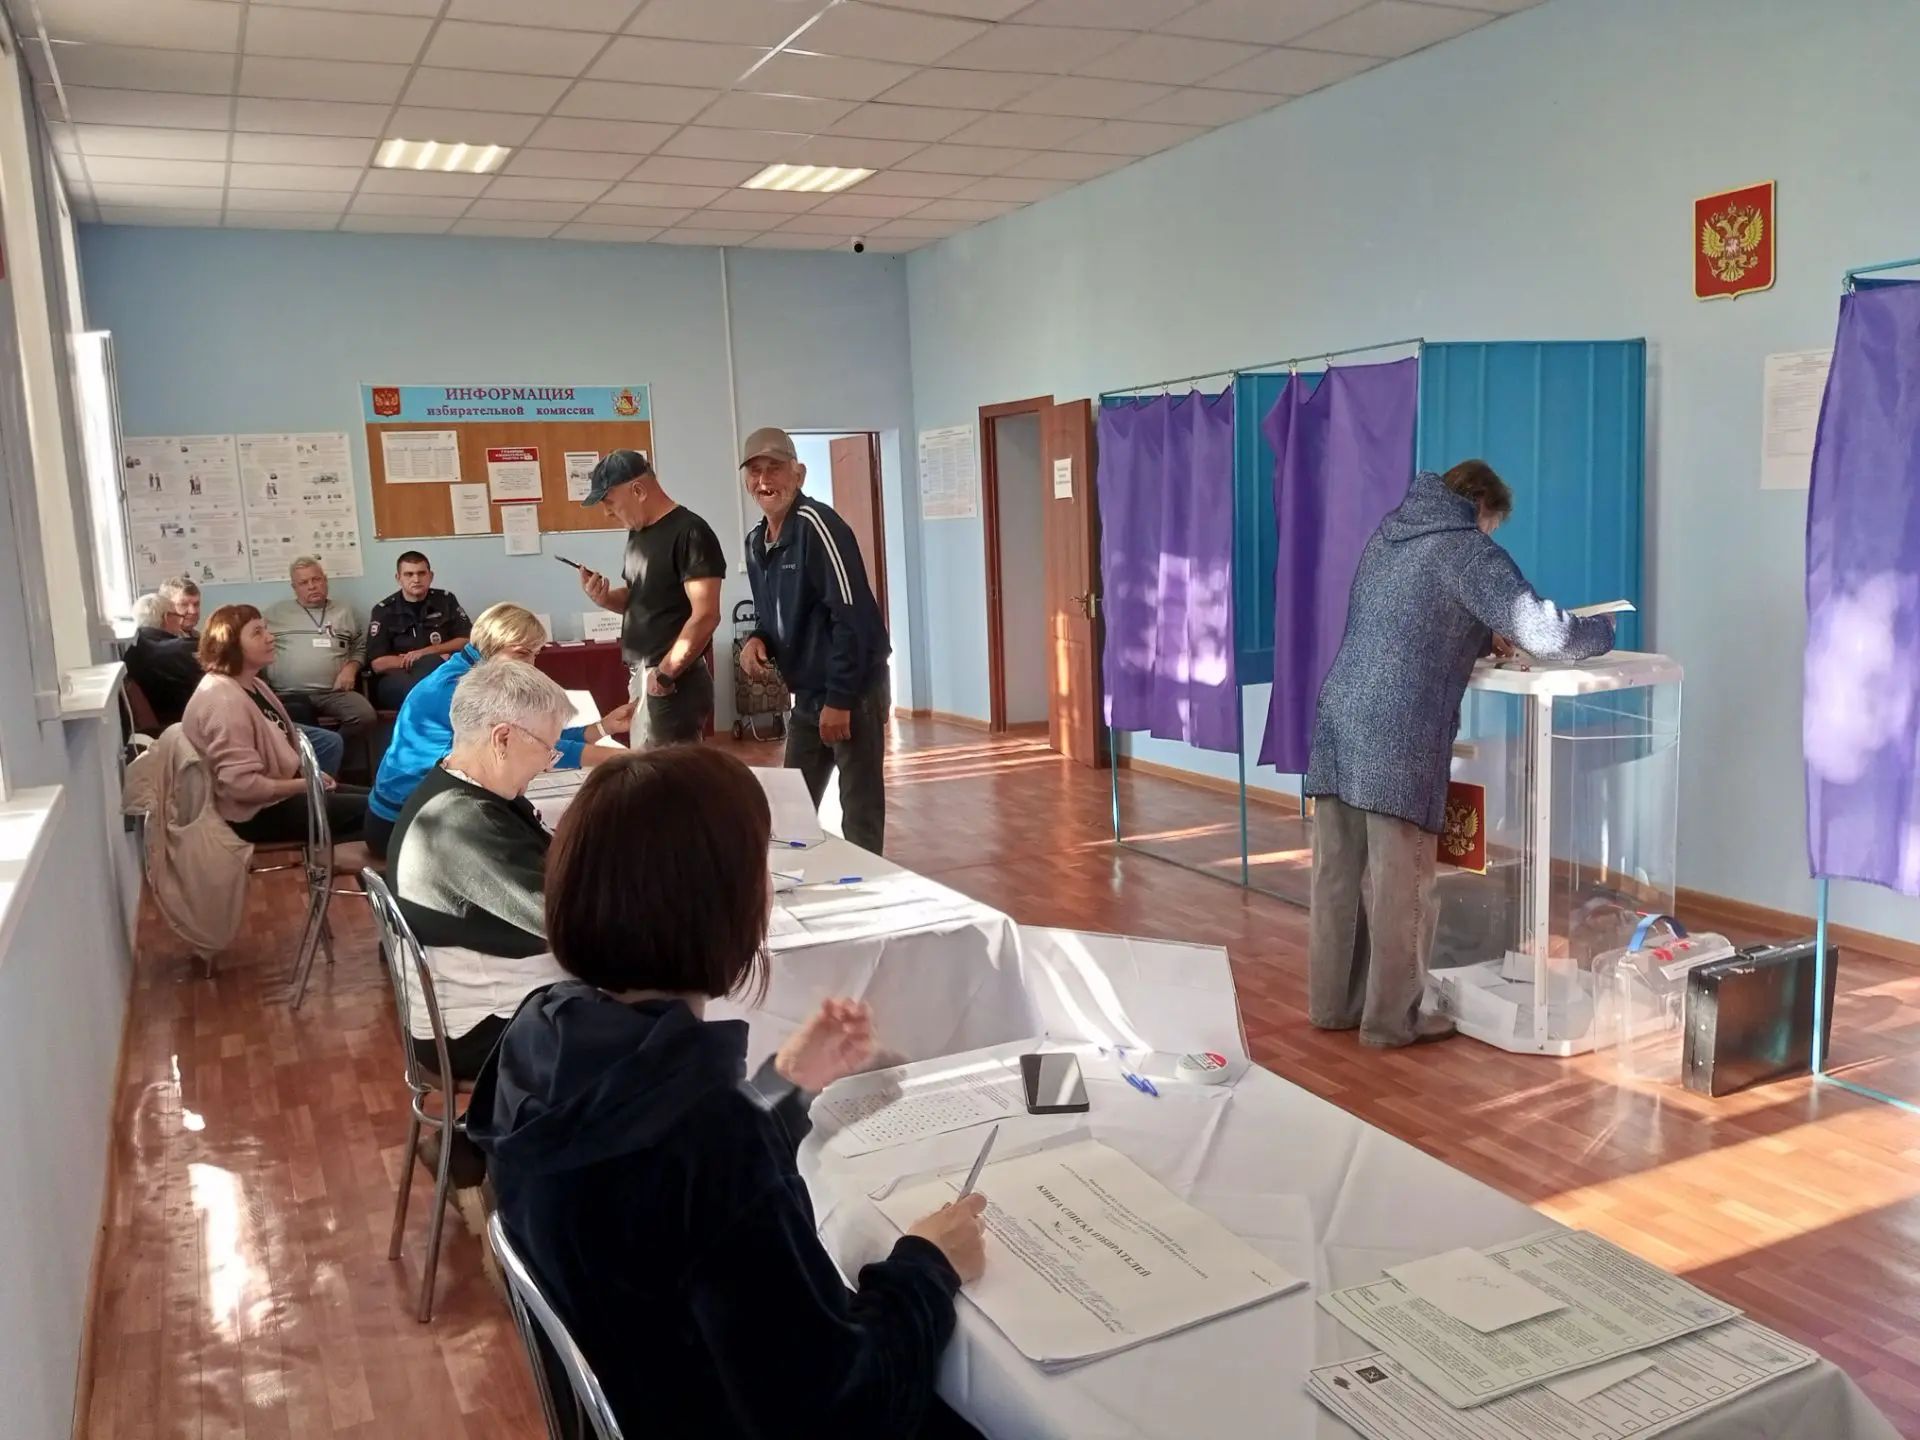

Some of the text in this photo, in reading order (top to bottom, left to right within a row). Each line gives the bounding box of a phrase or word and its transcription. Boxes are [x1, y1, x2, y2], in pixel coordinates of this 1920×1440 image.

[445, 388, 575, 402] ИНФОРМАЦИЯ
[426, 405, 595, 418] избирательной комиссии
[1036, 1185, 1063, 1208] КНИГА
[1061, 1207, 1094, 1233] СПИСКА
[1091, 1232, 1152, 1277] ИЗБИРАТЕЛЕЙ
